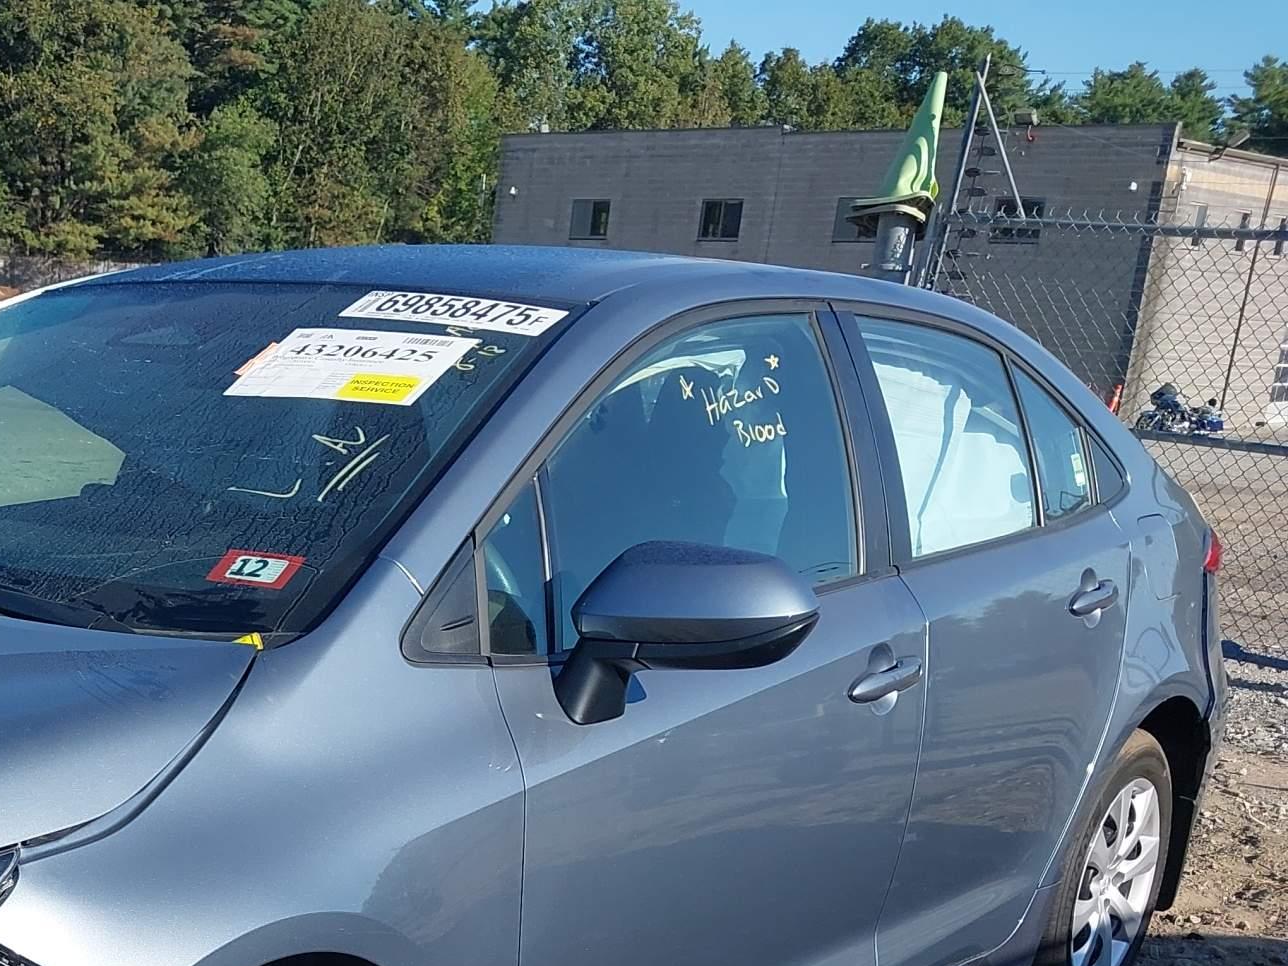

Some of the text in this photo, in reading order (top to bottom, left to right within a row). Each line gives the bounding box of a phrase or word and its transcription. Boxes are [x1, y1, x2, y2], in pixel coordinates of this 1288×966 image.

[375, 293, 539, 326] 69858475
[290, 343, 438, 363] 43206425
[351, 379, 414, 389] INSPECTION
[351, 386, 400, 395] SERVICE
[733, 411, 787, 448] Blood
[228, 557, 270, 578] 12
